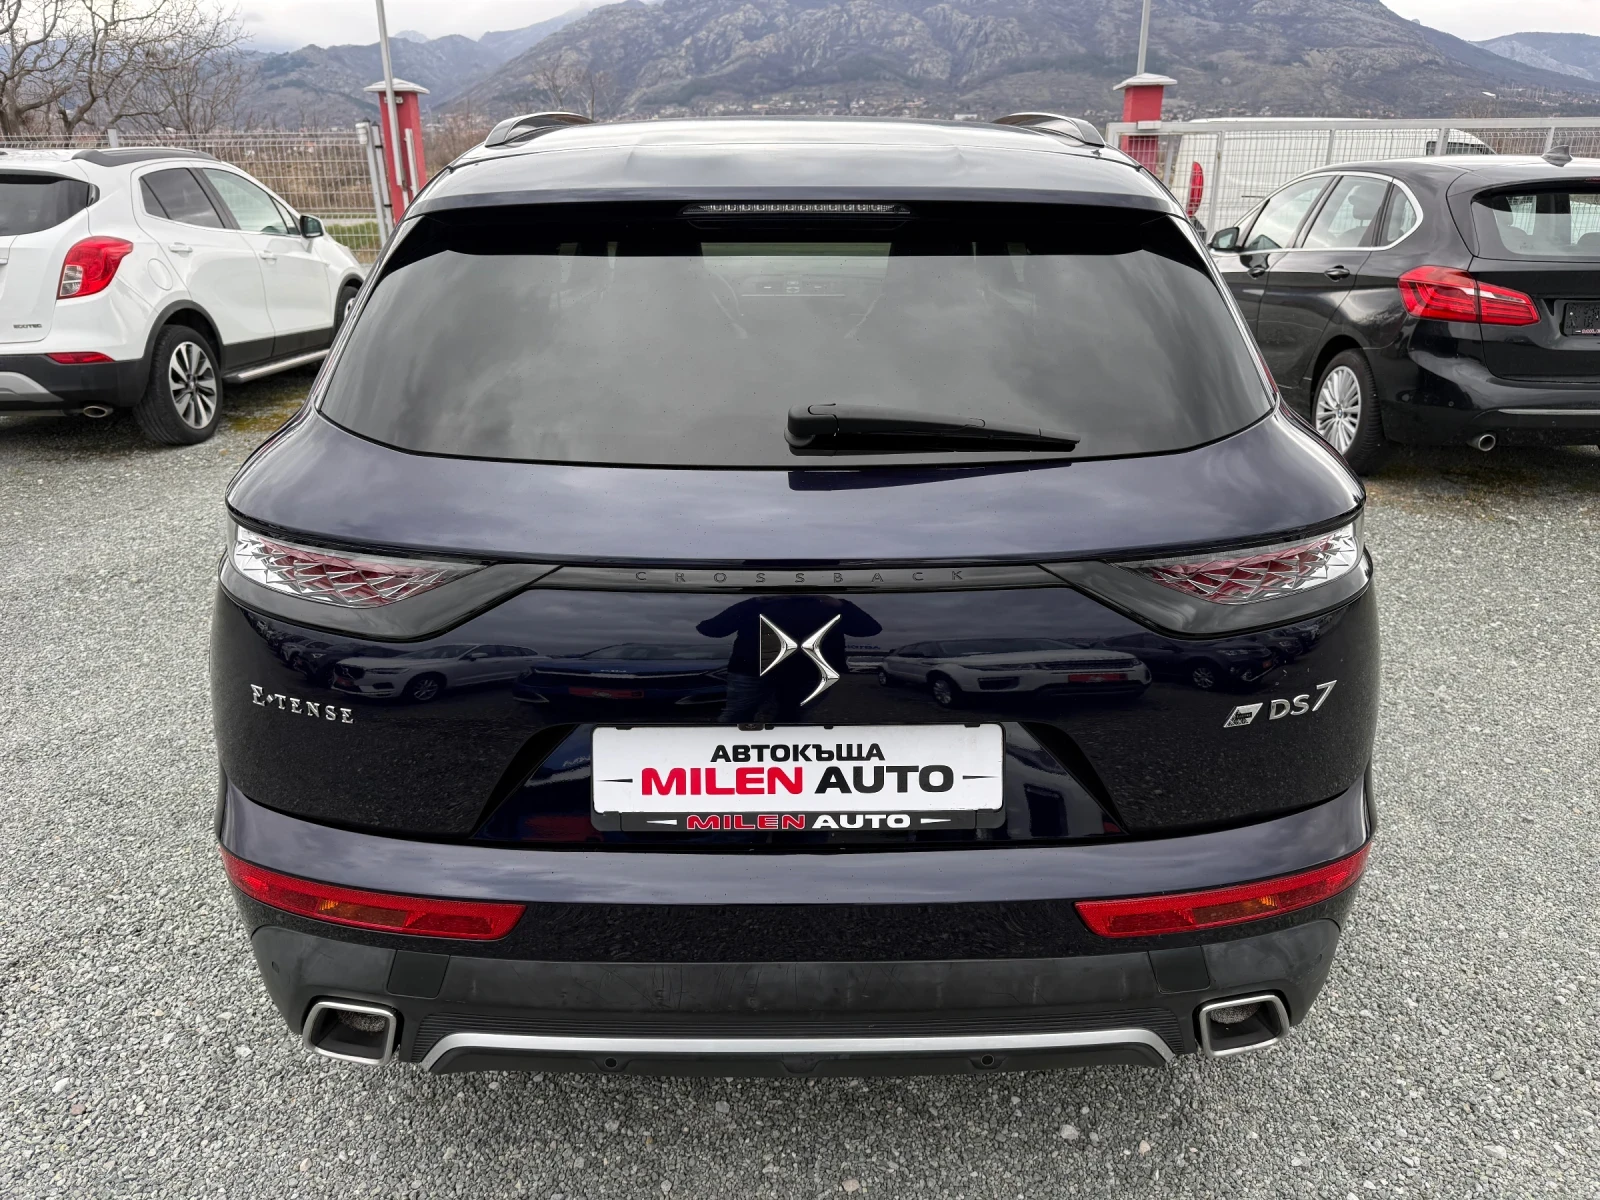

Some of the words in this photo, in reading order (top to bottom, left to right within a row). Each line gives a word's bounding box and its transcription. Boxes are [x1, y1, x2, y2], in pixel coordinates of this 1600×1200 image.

[635, 570, 964, 583] CROSSBACK
[641, 767, 803, 796] MILEN
[814, 765, 954, 794] AUTO
[686, 814, 806, 830] MILEN
[812, 814, 911, 829] AUTO
